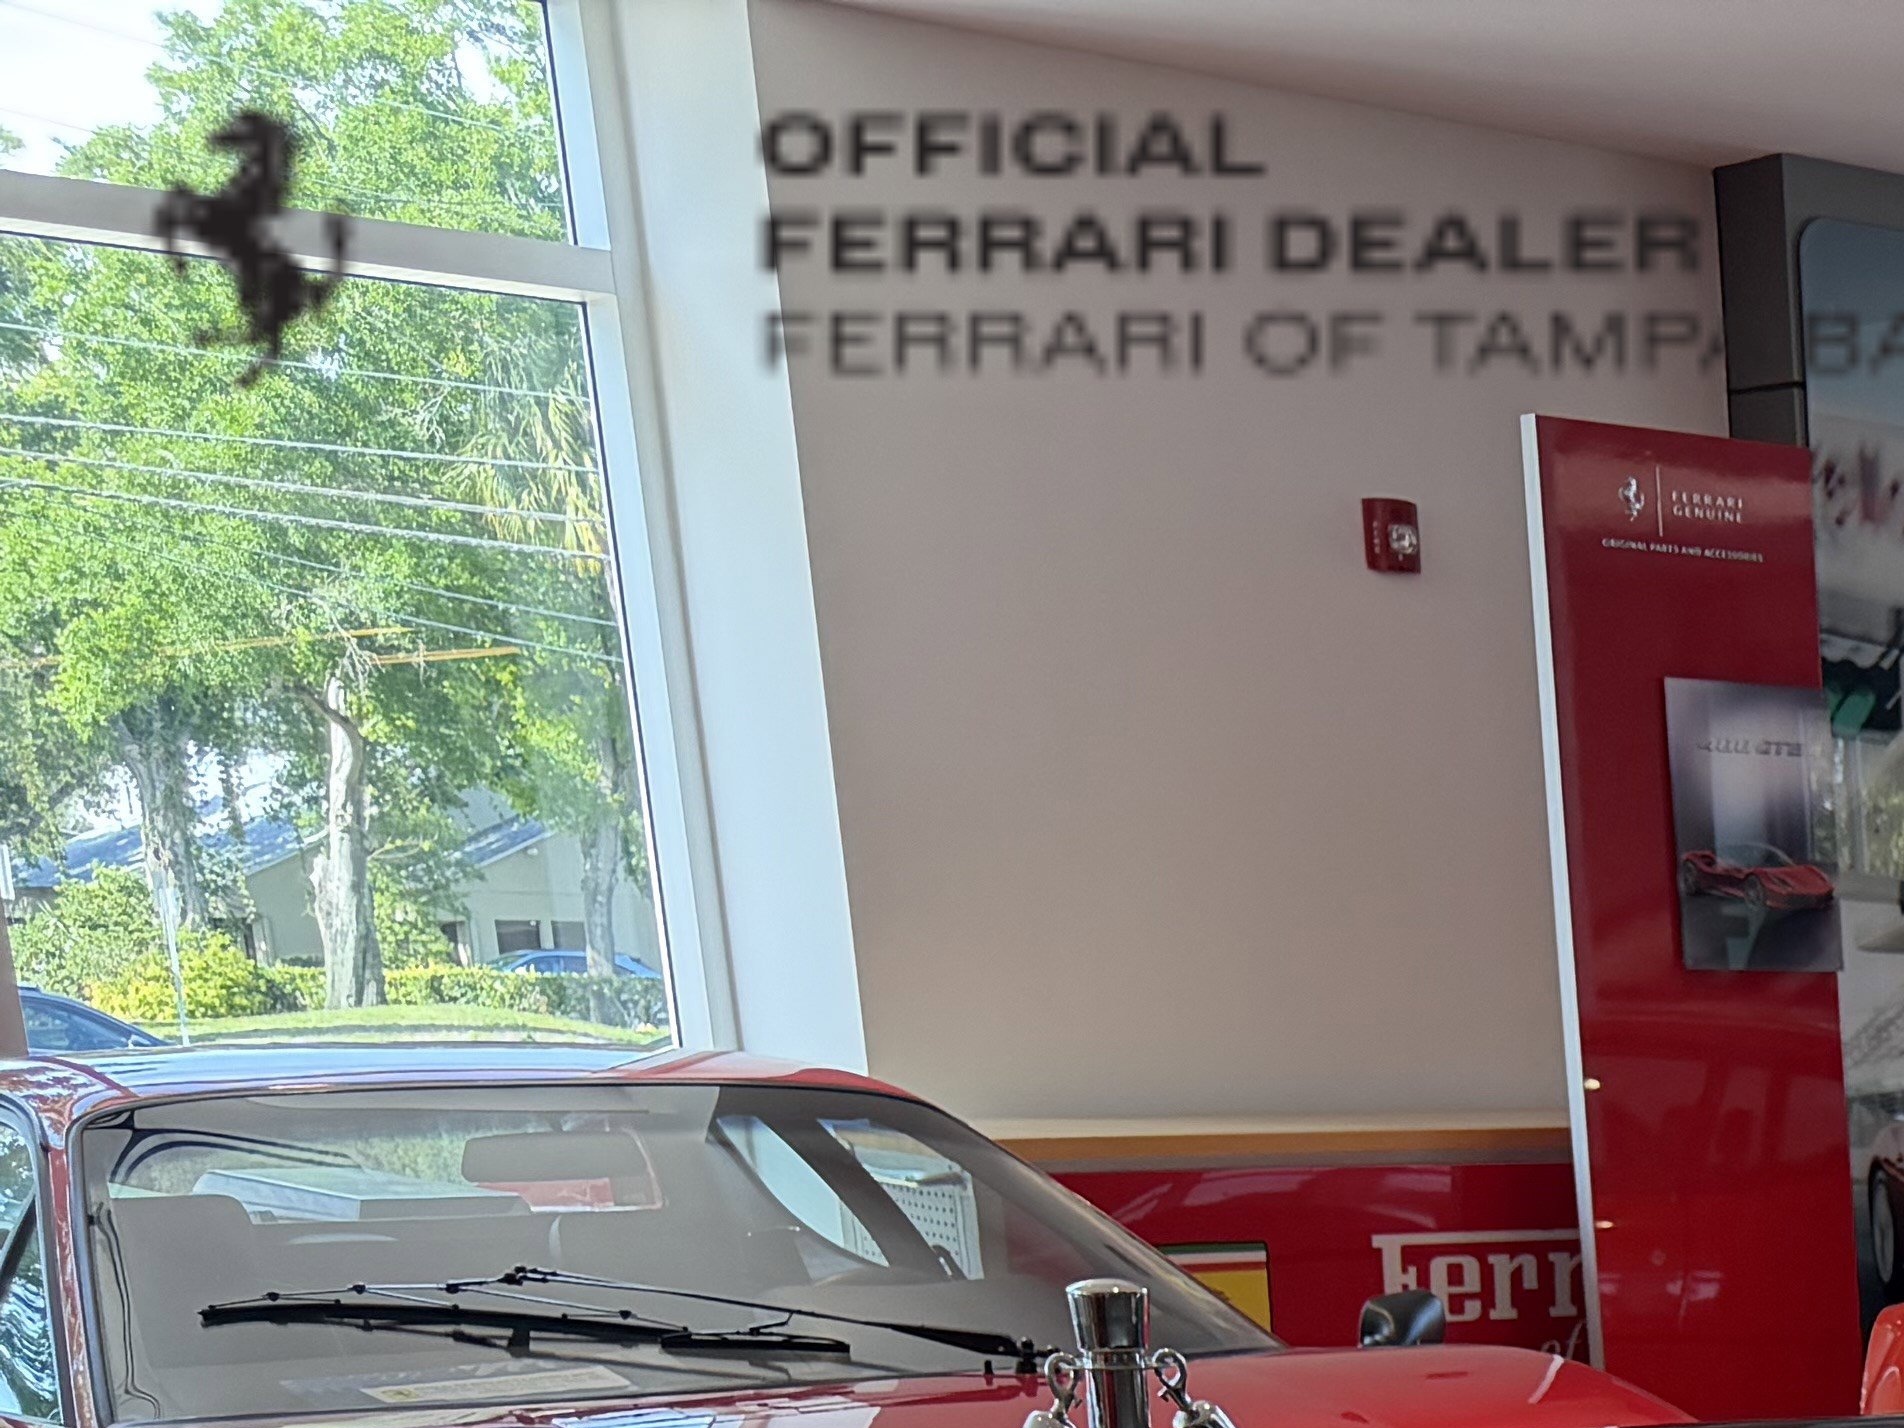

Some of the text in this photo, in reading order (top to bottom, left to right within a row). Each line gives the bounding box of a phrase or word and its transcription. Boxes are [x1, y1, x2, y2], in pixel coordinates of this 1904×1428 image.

[1672, 490, 1743, 509] FERRARI
[1673, 505, 1742, 523] GENUINE
[1650, 543, 1679, 554] PARTS
